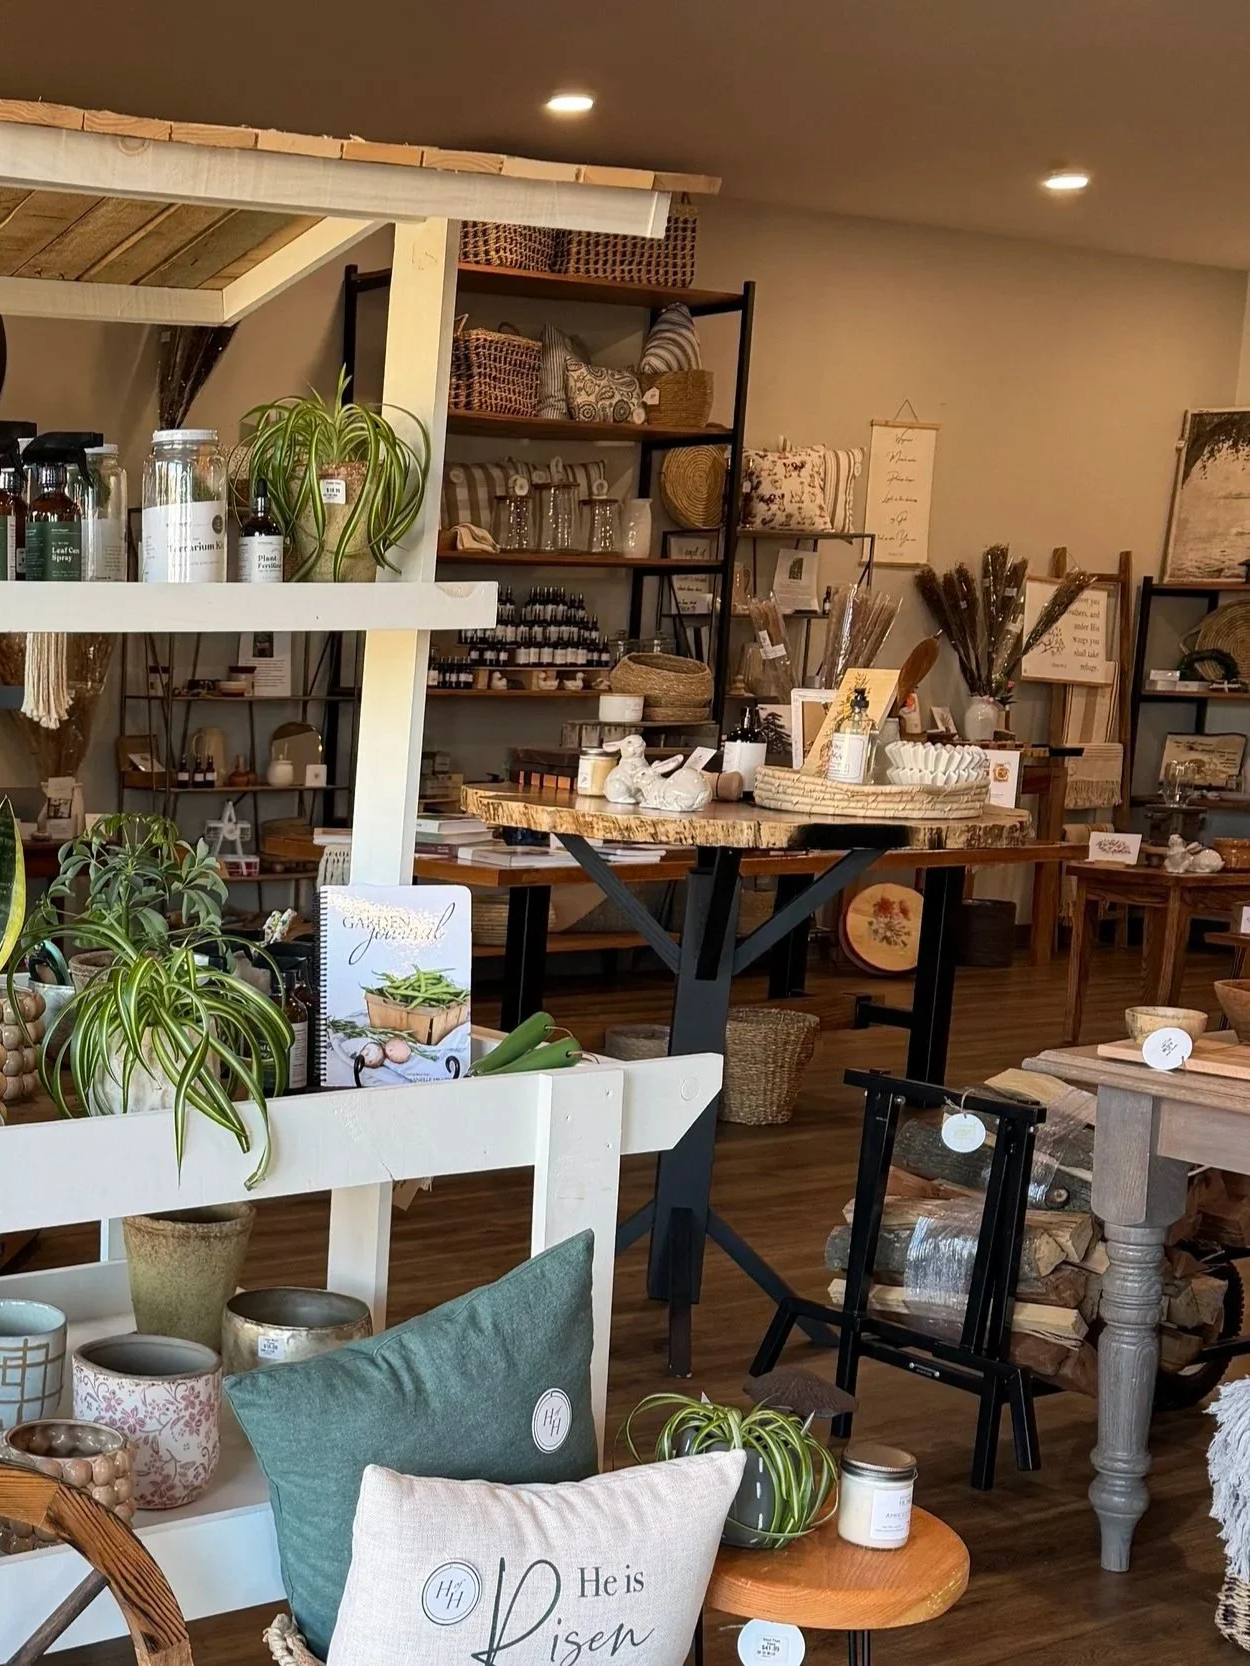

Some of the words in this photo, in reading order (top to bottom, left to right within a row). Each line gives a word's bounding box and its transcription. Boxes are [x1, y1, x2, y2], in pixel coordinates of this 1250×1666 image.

[51, 546, 68, 554] Leaf
[167, 541, 215, 553] Trrarium
[51, 554, 72, 562] Spray
[257, 554, 277, 562] Plant
[342, 914, 411, 930] GARDEN
[577, 1566, 618, 1598] He
[624, 1564, 645, 1594] is
[470, 1557, 655, 1666] Risen
